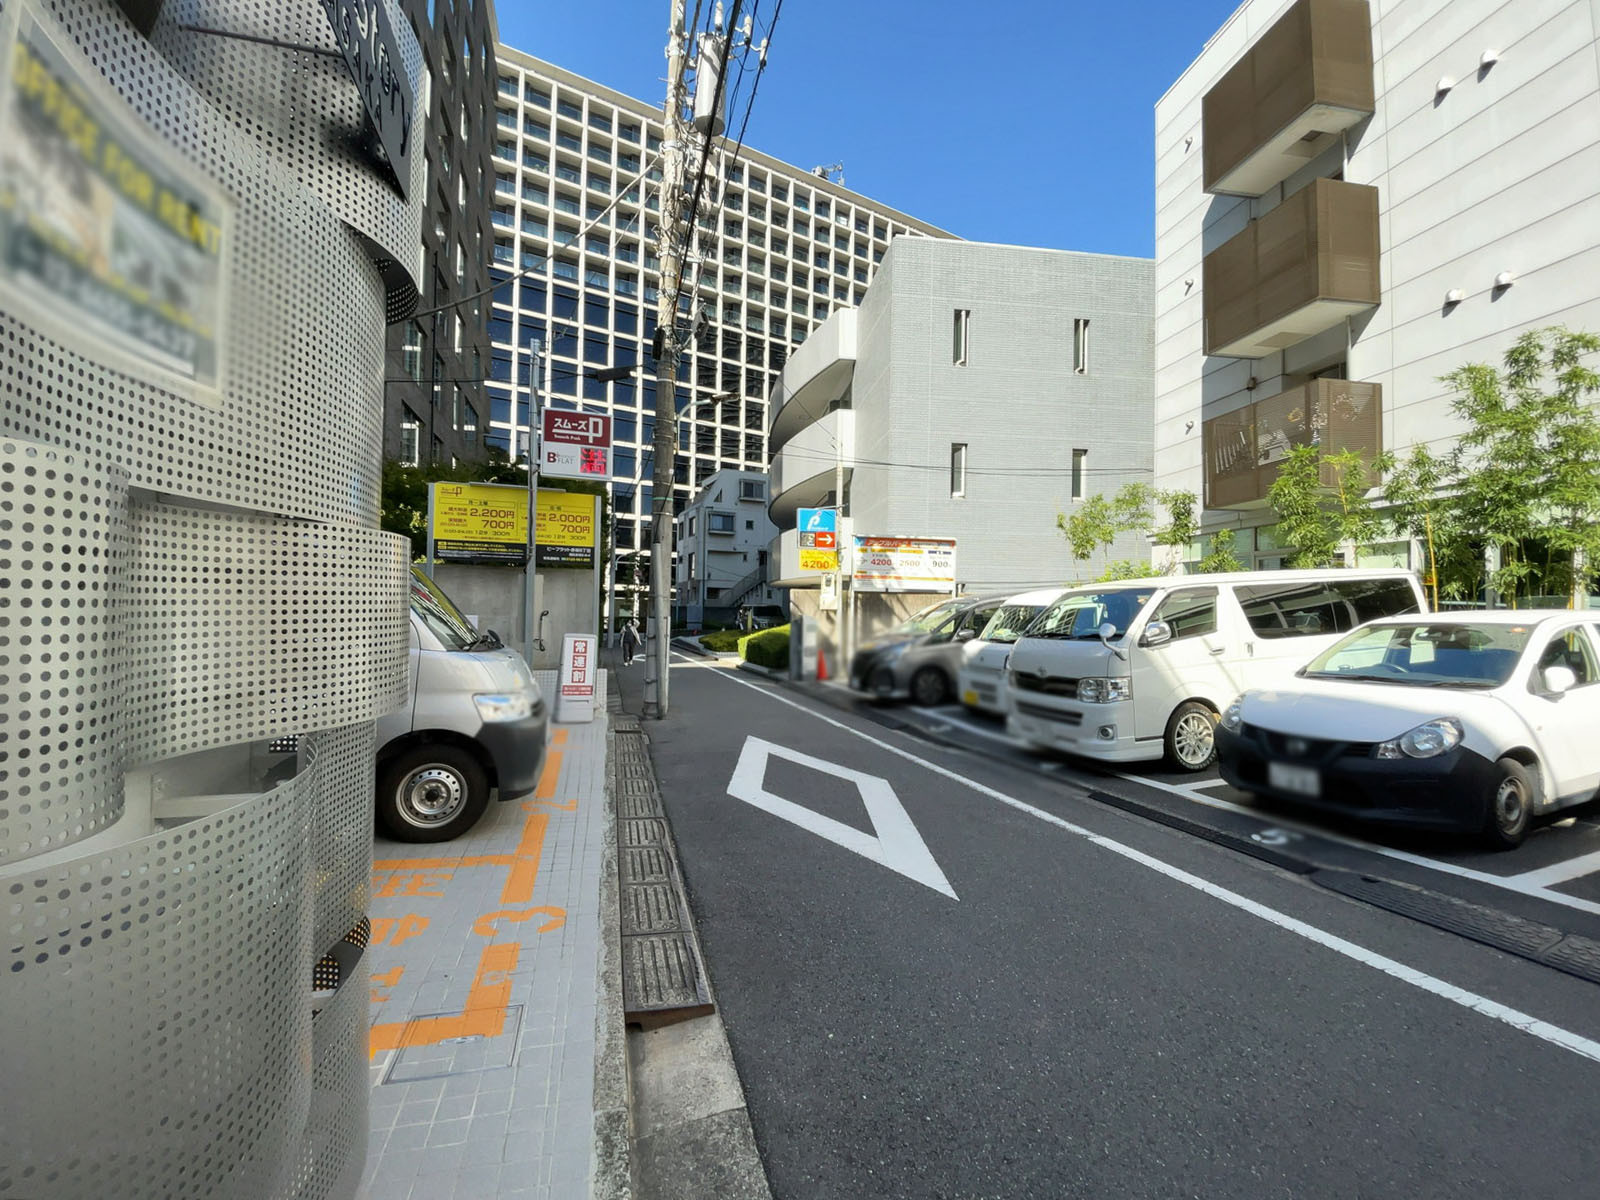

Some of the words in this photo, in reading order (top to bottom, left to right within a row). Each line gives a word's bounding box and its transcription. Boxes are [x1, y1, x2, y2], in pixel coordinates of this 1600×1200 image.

[482, 520, 514, 530] 700円
[560, 524, 590, 534] 700円
[802, 560, 830, 570] 4200
